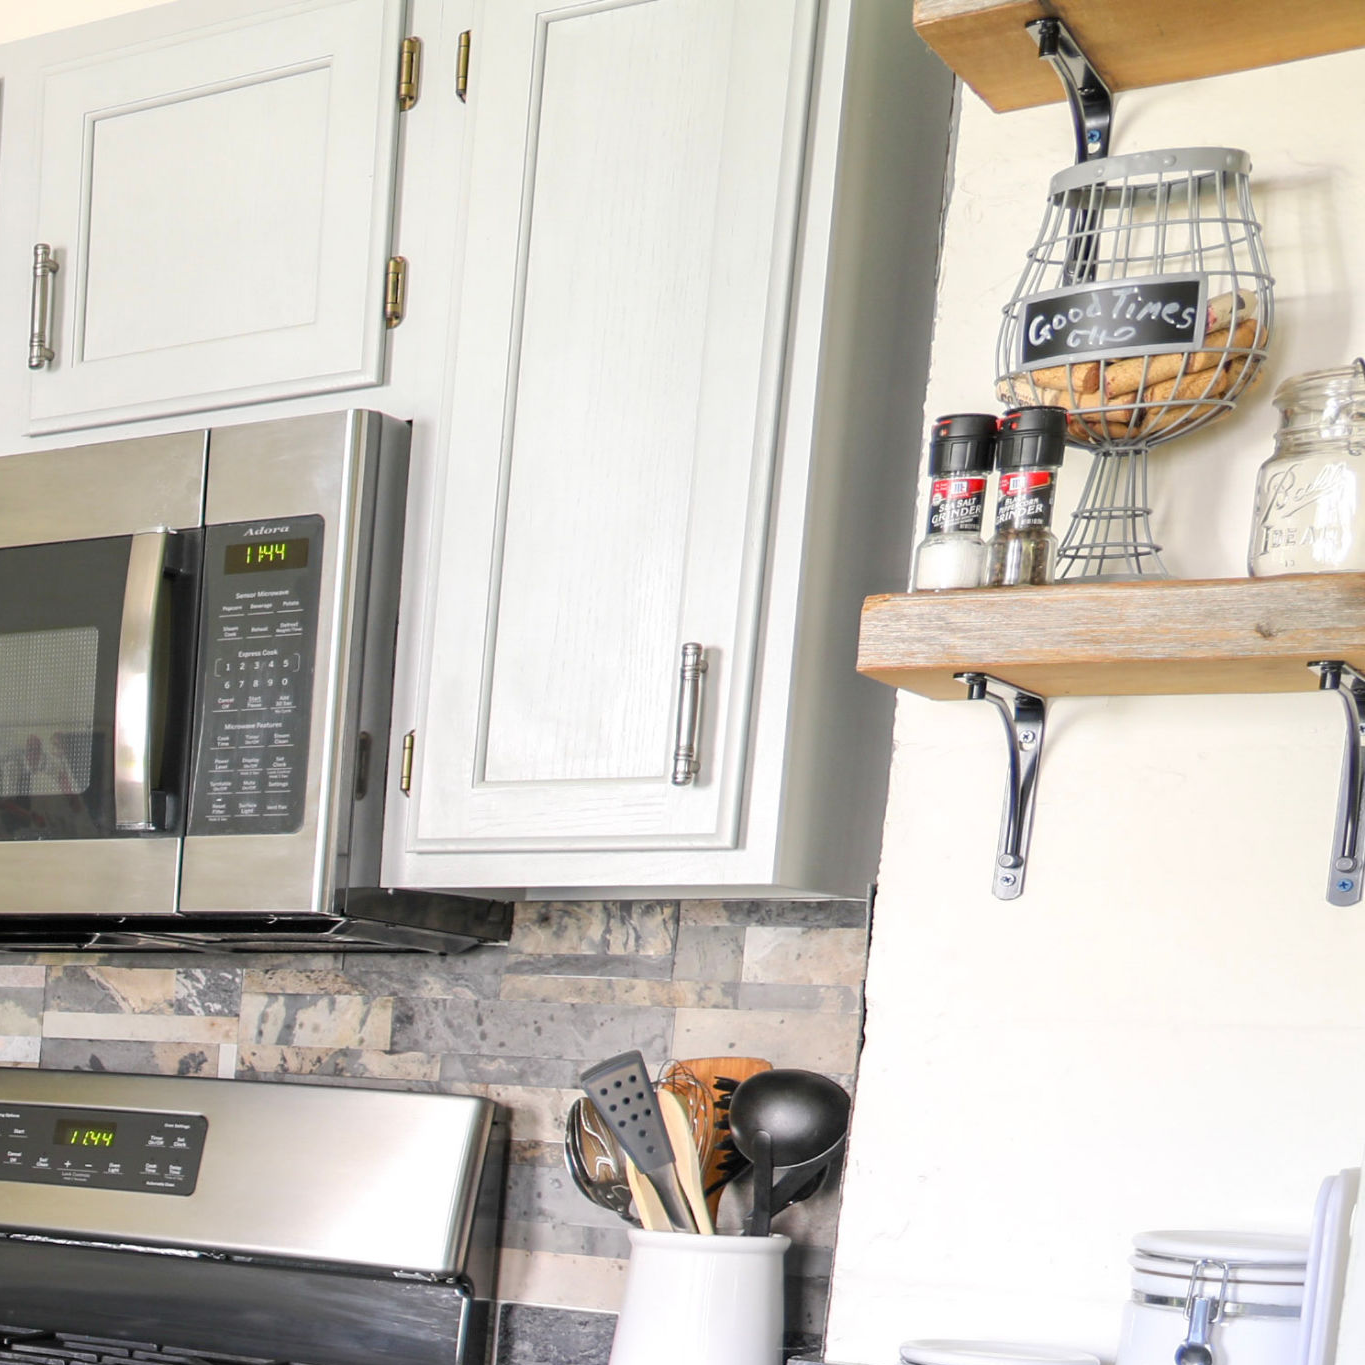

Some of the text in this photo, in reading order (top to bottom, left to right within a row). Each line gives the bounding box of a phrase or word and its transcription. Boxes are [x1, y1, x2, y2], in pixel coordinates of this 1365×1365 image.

[958, 498, 978, 507] SALT
[931, 504, 982, 524] GRINDER
[243, 526, 290, 537] Adora
[262, 648, 278, 656] Cook
